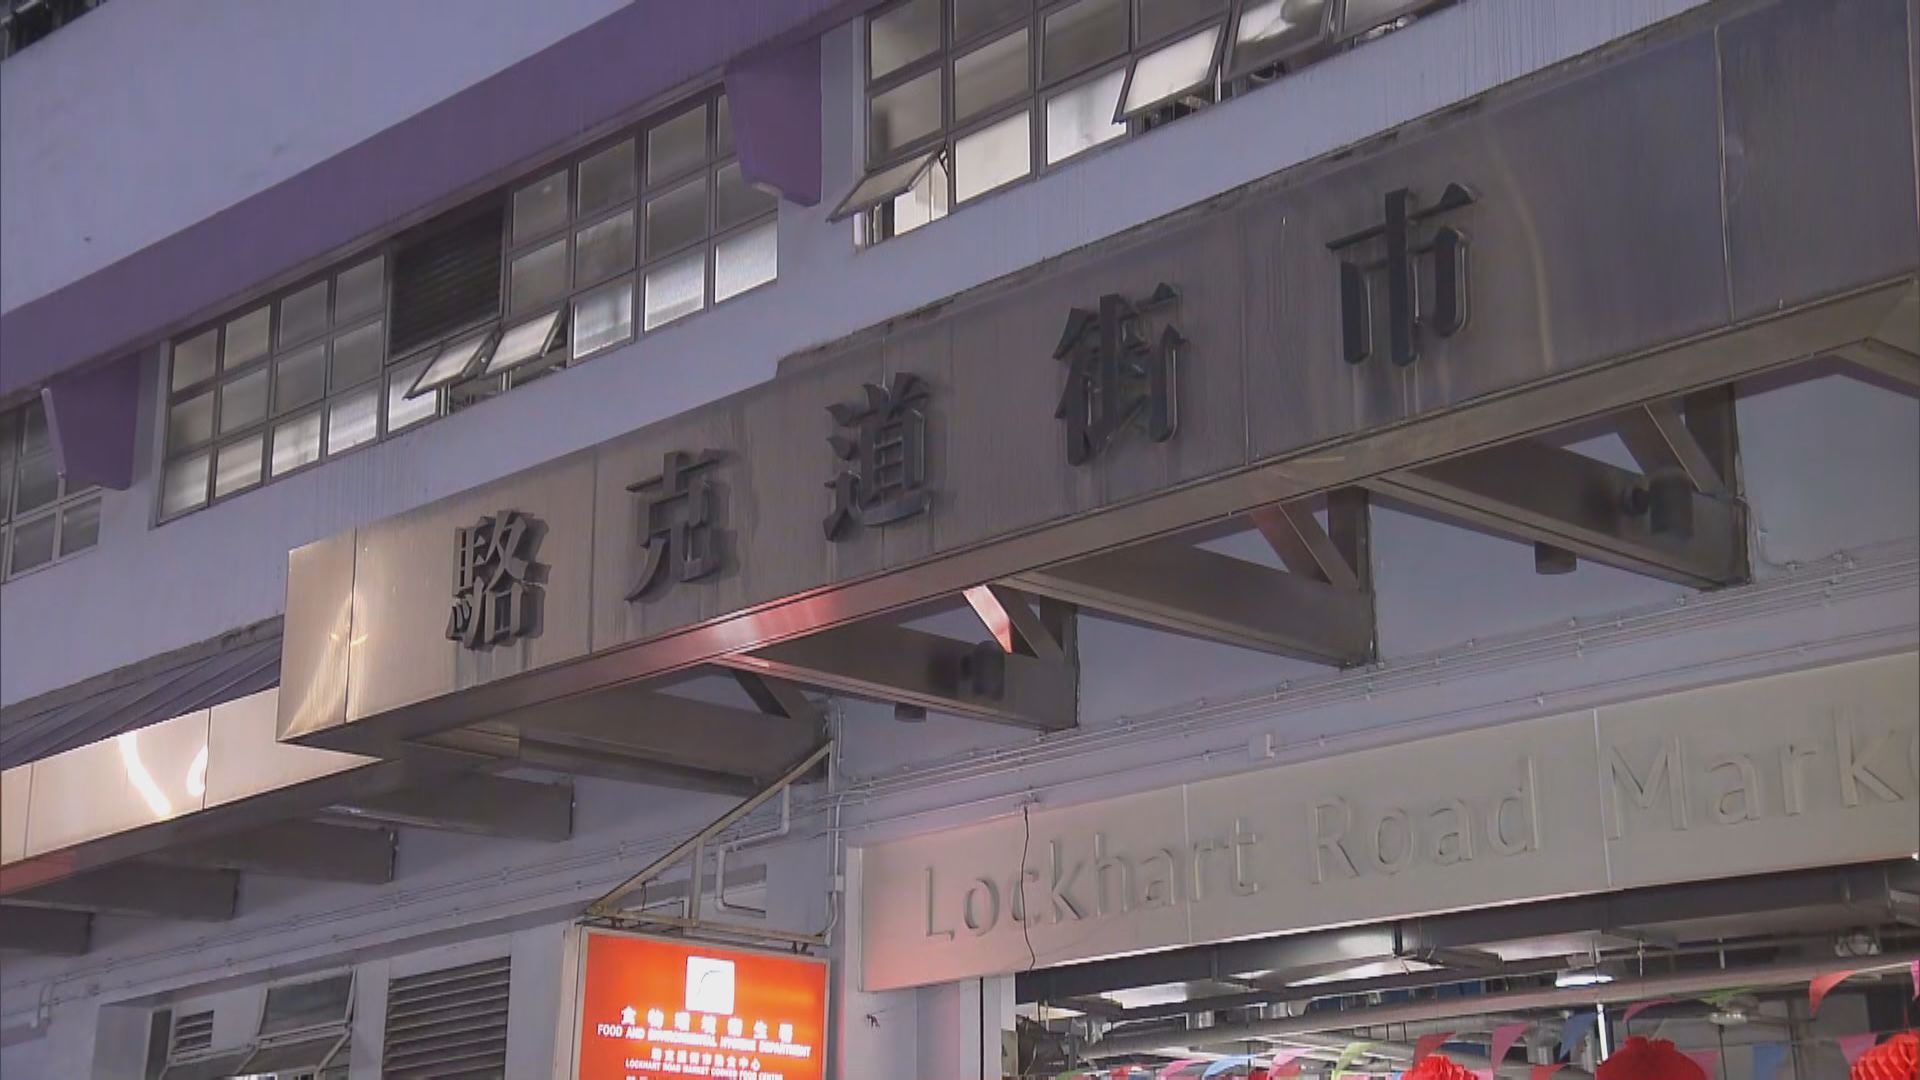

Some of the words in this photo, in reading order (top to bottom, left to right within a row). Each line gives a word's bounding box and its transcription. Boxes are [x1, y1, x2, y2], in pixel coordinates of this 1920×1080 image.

[446, 182, 1475, 649] 駱克道街市
[924, 818, 1260, 939] Lockhart
[1308, 755, 1540, 885] Road
[1602, 706, 1917, 841] Mark
[597, 1023, 623, 1037] FOOD
[625, 1025, 646, 1040] AND
